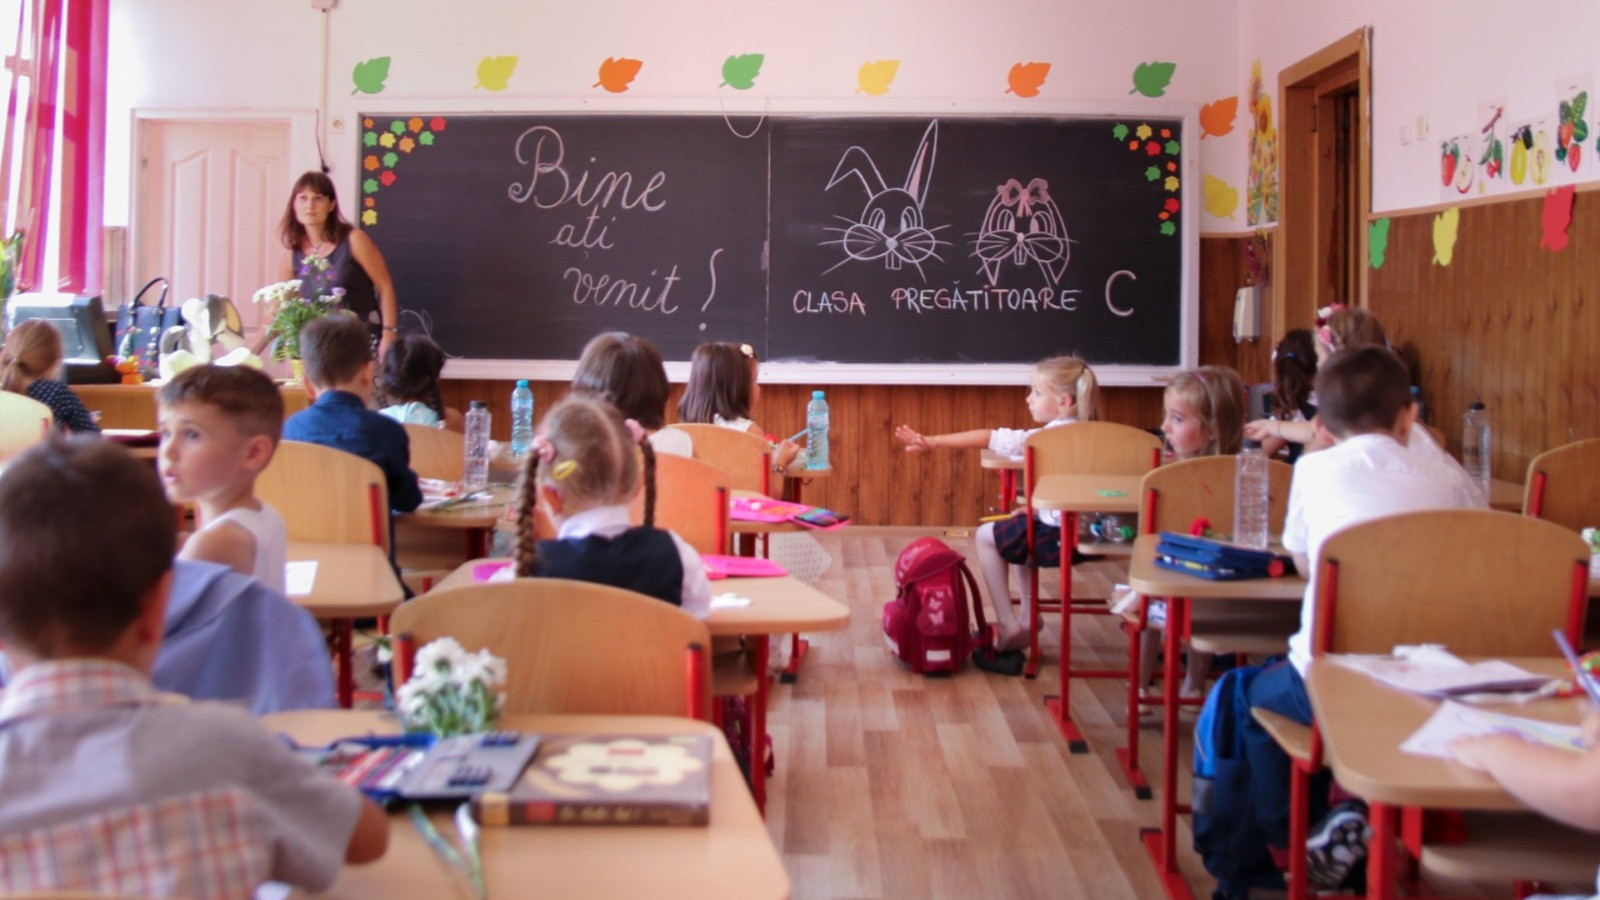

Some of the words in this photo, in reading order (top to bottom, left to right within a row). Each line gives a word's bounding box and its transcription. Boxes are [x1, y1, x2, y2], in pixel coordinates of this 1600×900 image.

[508, 125, 667, 212] Bine
[563, 265, 681, 315] venit
[793, 290, 866, 316] CLASA
[1105, 270, 1137, 317] C
